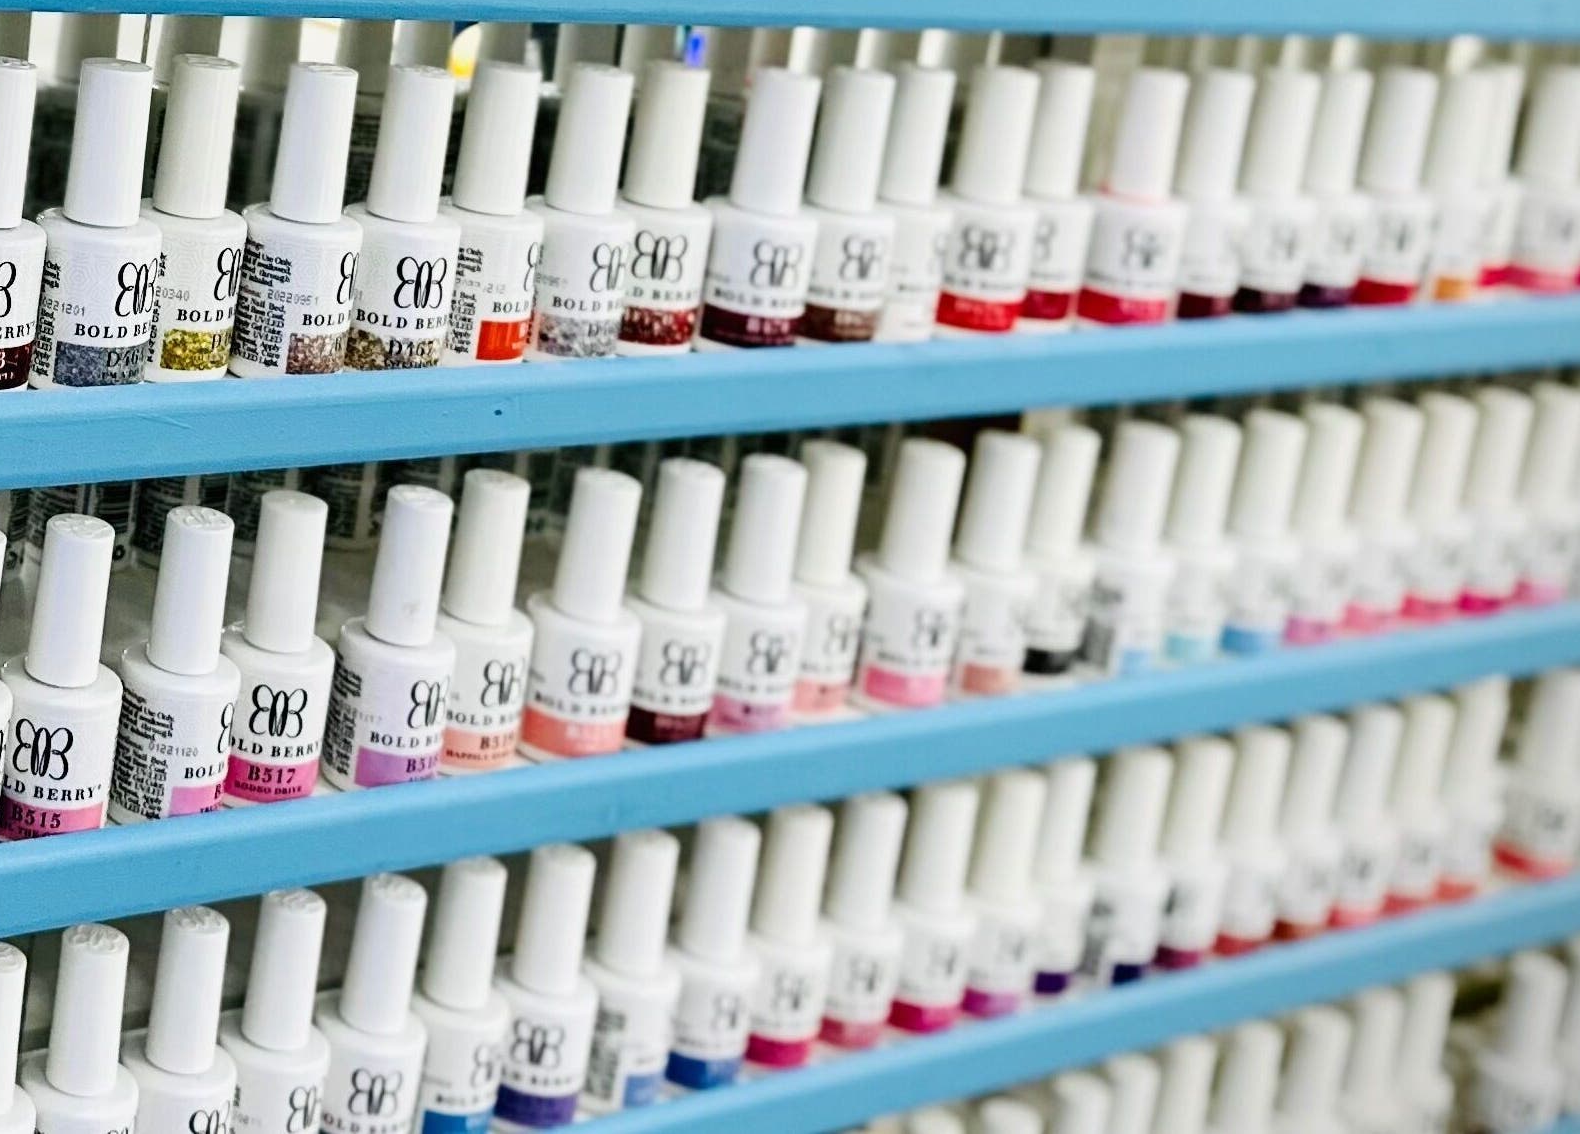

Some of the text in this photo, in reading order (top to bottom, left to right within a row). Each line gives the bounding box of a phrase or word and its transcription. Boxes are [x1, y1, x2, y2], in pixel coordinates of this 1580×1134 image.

[552, 295, 601, 312] BOLD
[177, 308, 224, 323] BOLD
[302, 312, 344, 328] BOLD
[356, 309, 408, 331] BOLD
[74, 322, 128, 340] BOLD
[370, 730, 420, 748] BOLD
[247, 765, 297, 785] B517
[234, 780, 303, 797] RODEO DRIVE
[12, 805, 62, 830] B515
